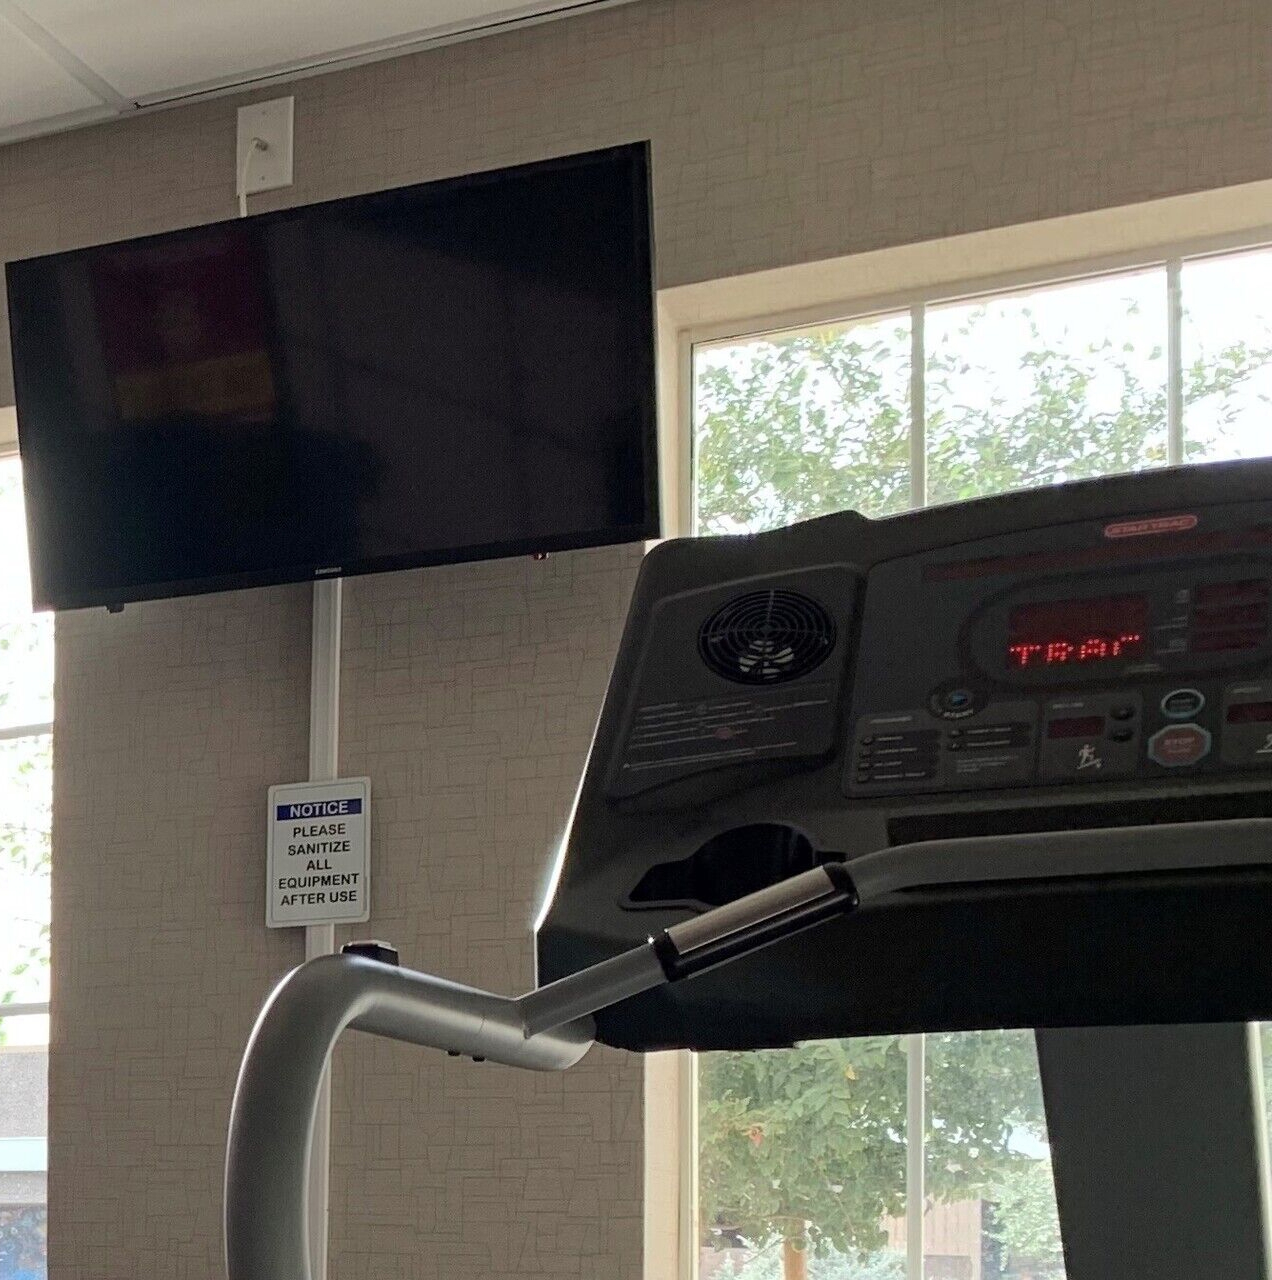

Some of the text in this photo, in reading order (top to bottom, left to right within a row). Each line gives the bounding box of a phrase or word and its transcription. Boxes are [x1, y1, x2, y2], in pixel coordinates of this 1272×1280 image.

[289, 800, 349, 818] NOTICE
[293, 823, 346, 838] PLEASE
[288, 840, 351, 856] SANITIZE
[306, 859, 332, 871] ALL
[278, 873, 360, 889] EQUIPMENT
[280, 891, 357, 906] AFTER USE
